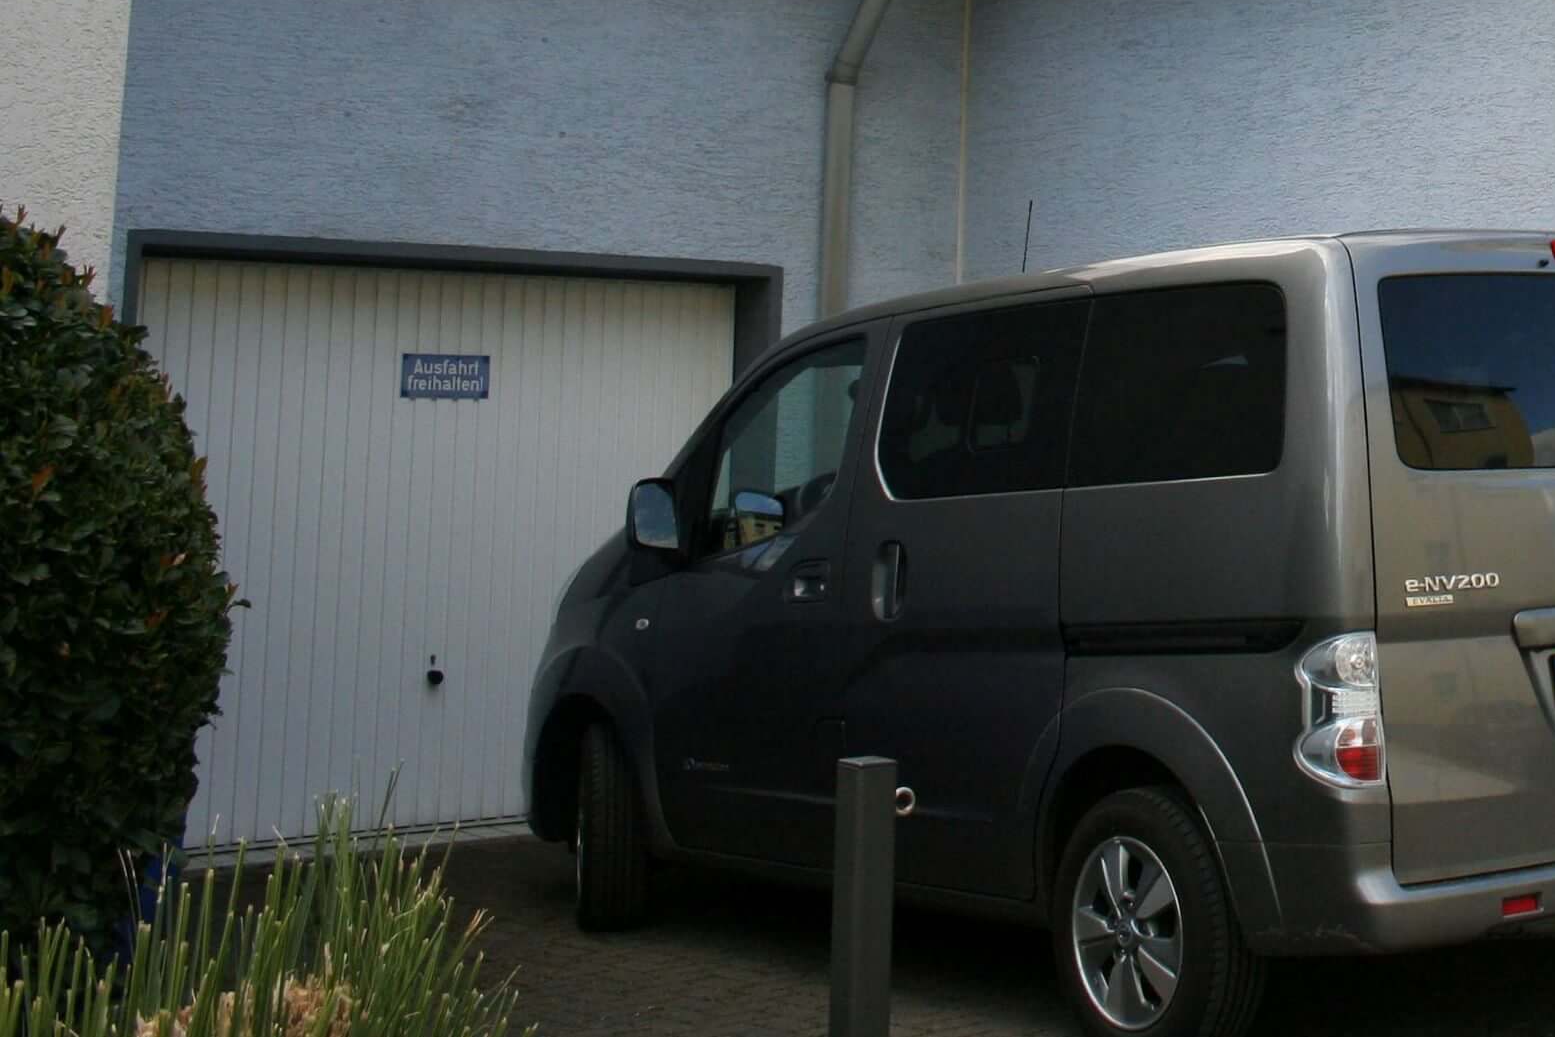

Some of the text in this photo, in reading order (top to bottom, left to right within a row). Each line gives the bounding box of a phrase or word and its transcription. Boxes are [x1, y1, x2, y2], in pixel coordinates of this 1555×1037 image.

[413, 359, 480, 376] Ausfahrt
[407, 375, 484, 392] freihalten!
[1405, 572, 1500, 592] e-NV200
